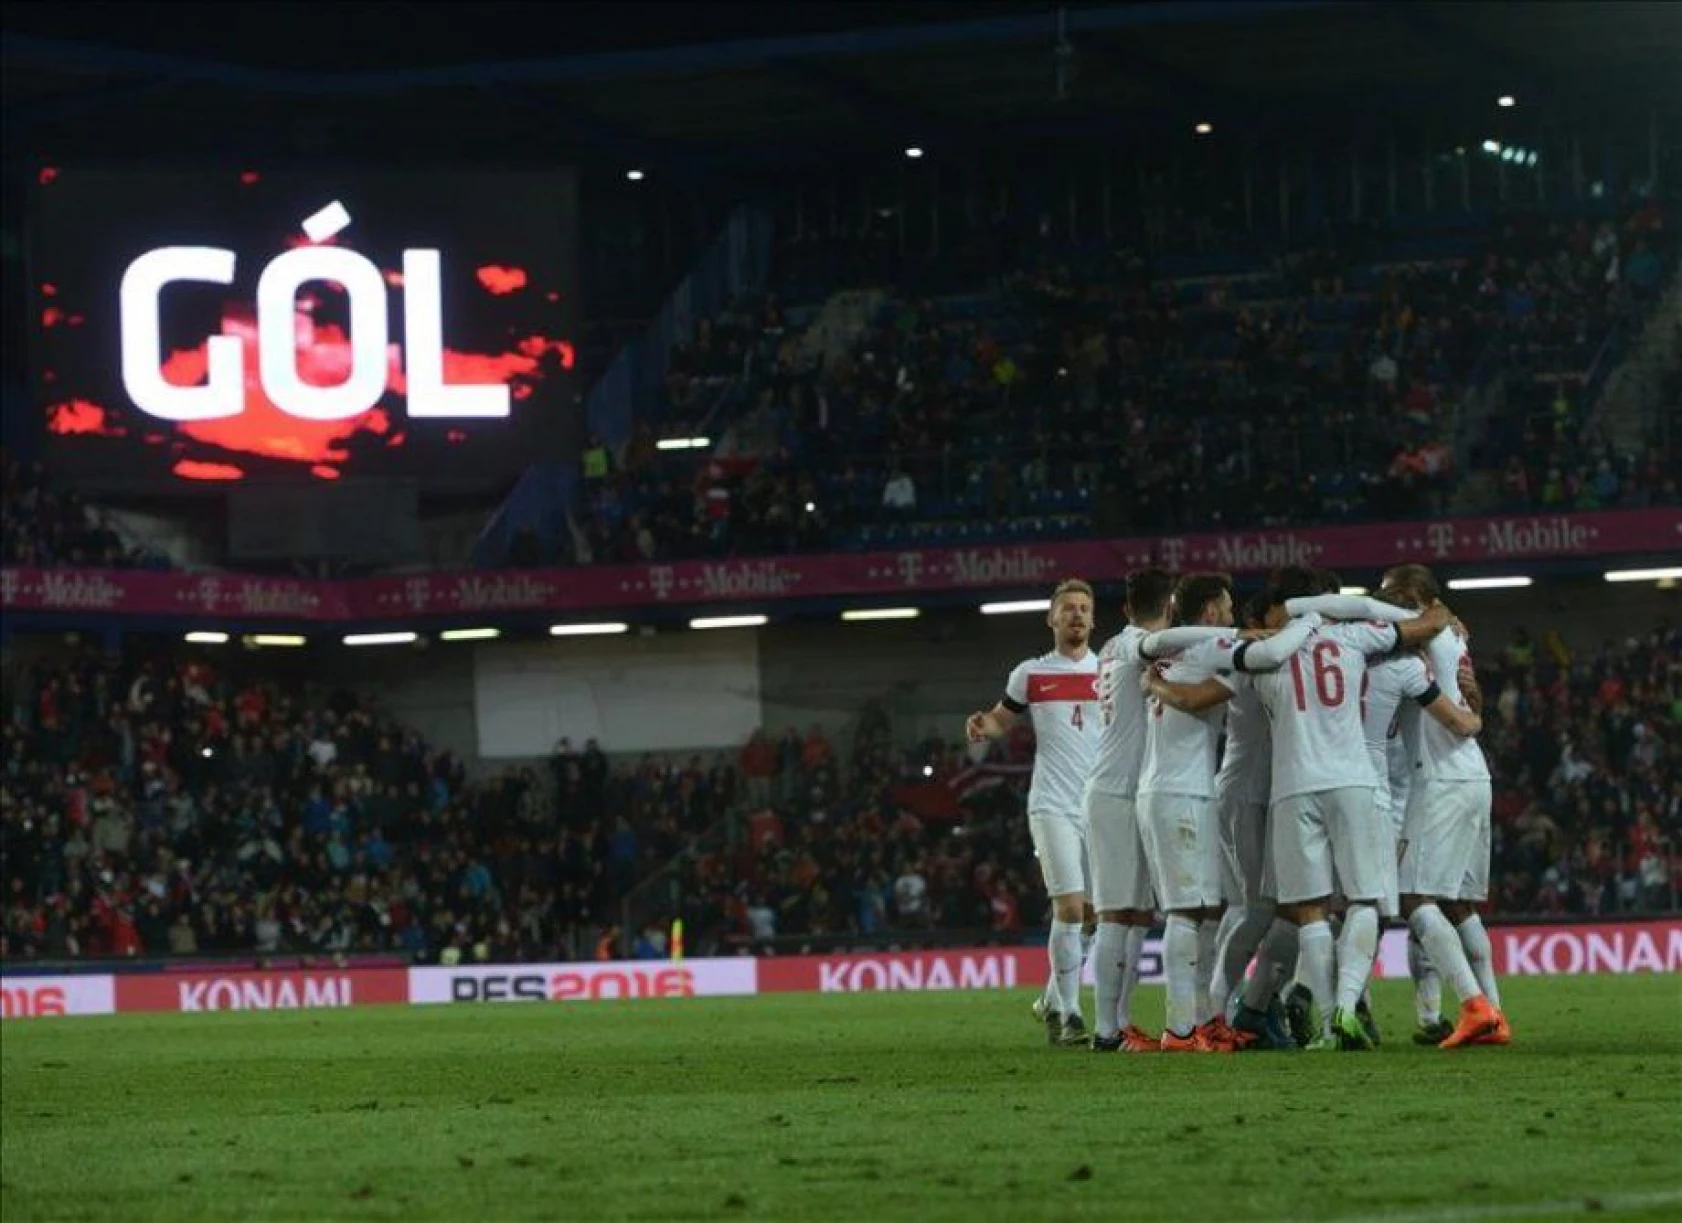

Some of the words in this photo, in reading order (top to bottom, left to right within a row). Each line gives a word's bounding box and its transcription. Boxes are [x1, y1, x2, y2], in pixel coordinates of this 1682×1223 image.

[120, 200, 511, 420] GÓL
[1217, 535, 1314, 569] Mobile
[1488, 518, 1587, 554] Mobile
[701, 563, 792, 595] Mobile
[951, 549, 1046, 584] Mobile
[1289, 639, 1345, 713] 16
[1071, 704, 1083, 732] 4
[819, 954, 1017, 993] KONAMI
[179, 977, 351, 1013] KONAMI
